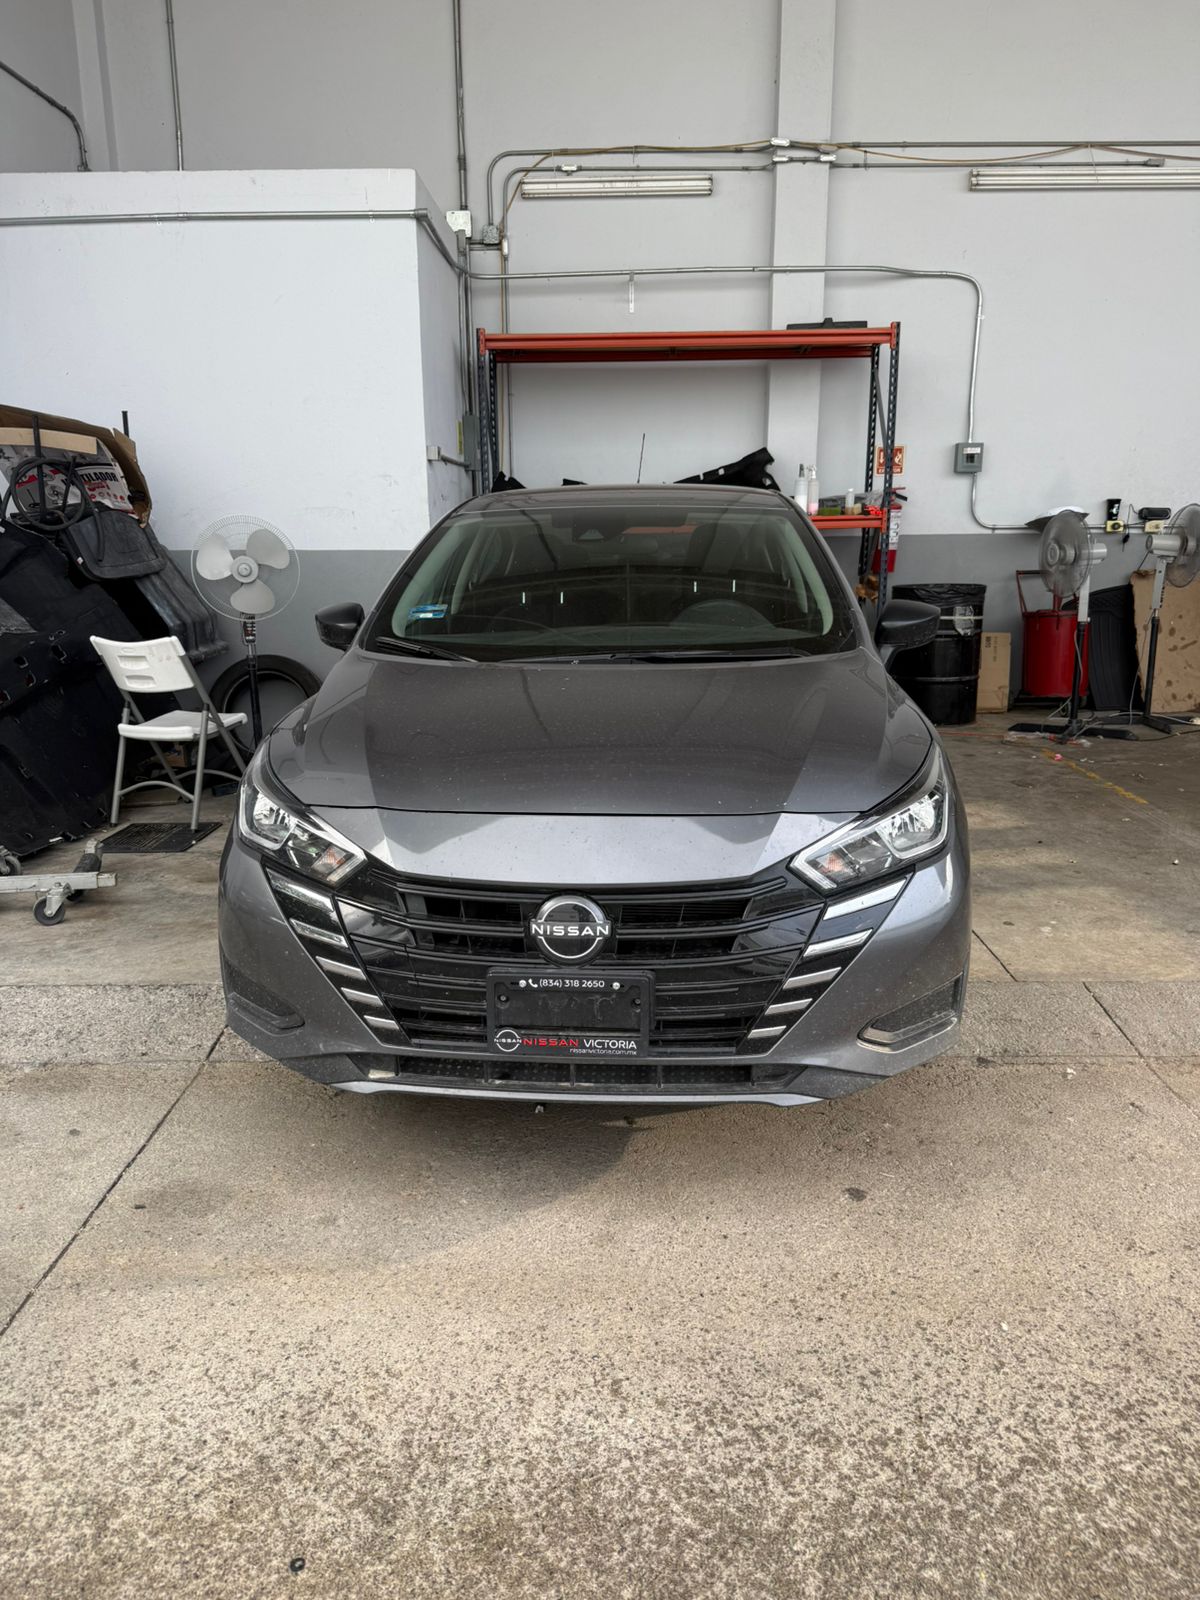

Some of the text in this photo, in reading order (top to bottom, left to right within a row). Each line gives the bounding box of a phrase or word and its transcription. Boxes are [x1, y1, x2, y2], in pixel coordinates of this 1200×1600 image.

[532, 924, 609, 936] NISSAN
[539, 978, 605, 988] (834) 318 2650
[523, 1037, 637, 1049] NISSAN VICTORIA
